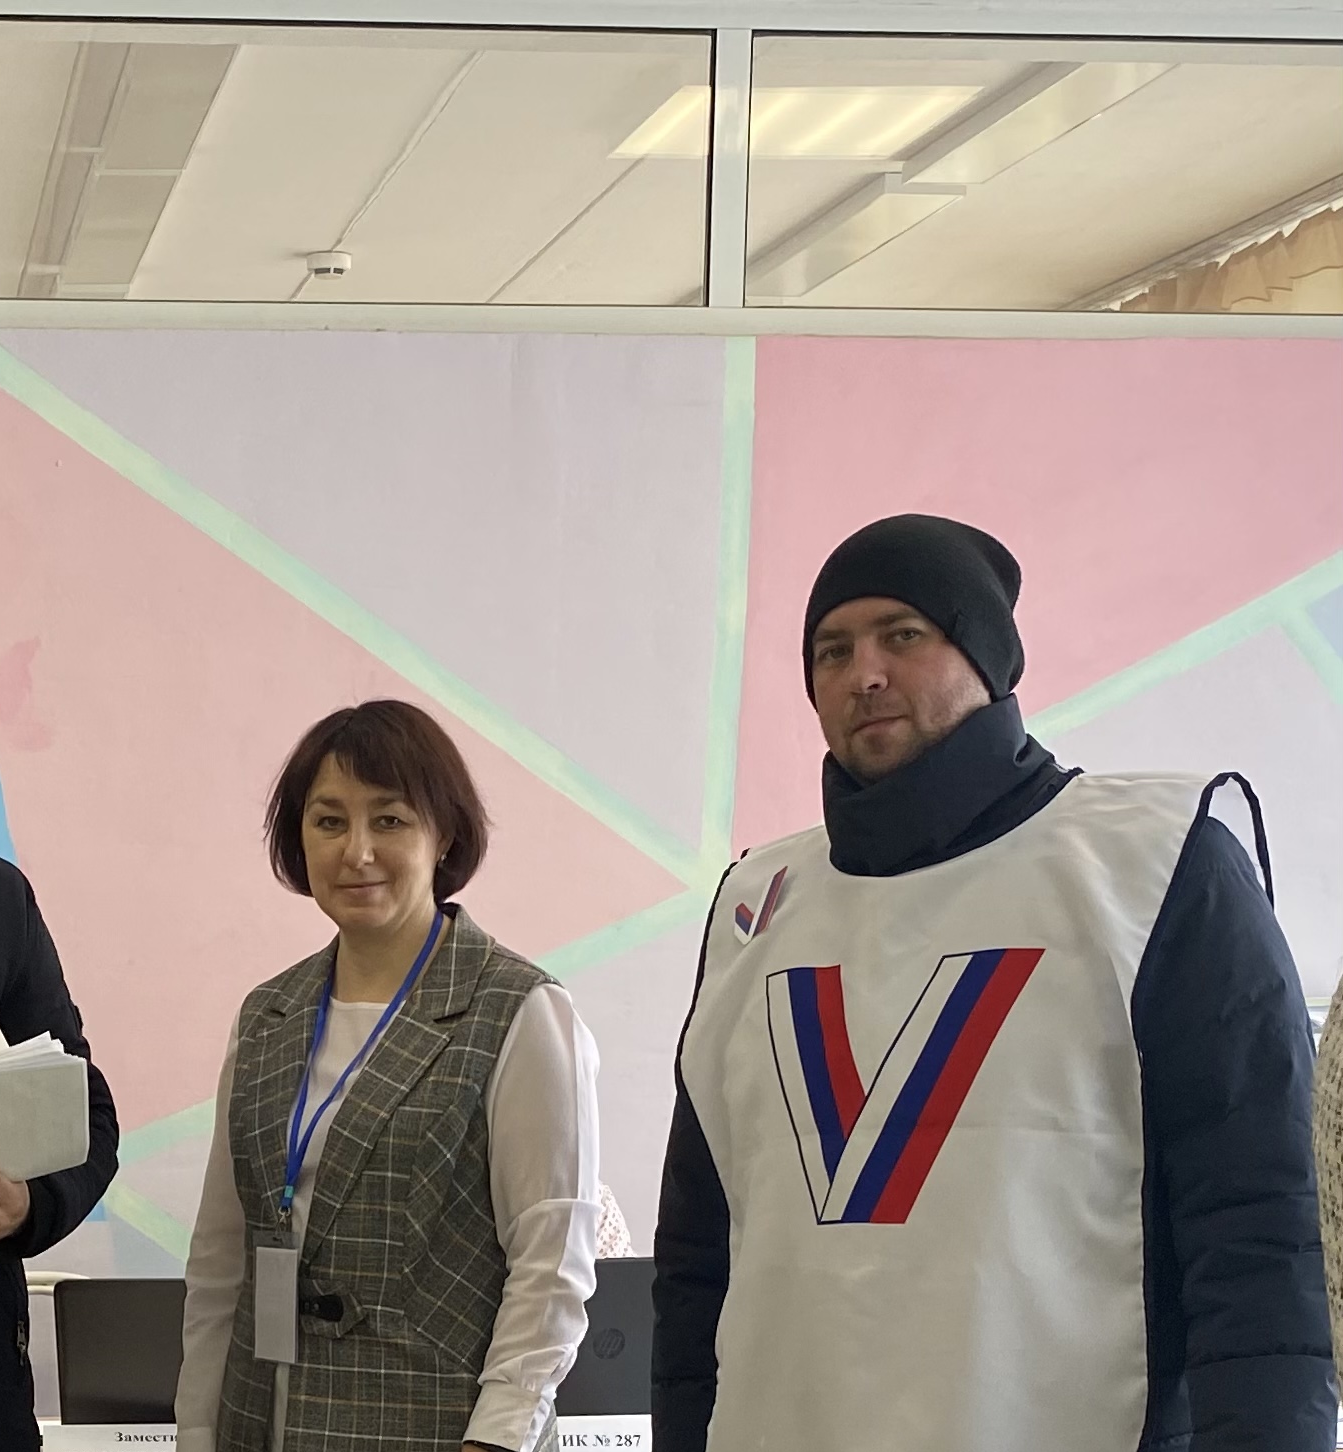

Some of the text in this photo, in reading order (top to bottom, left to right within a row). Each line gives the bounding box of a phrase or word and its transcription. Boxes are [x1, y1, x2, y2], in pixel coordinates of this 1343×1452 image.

[558, 1434, 641, 1447] ИК № 287
